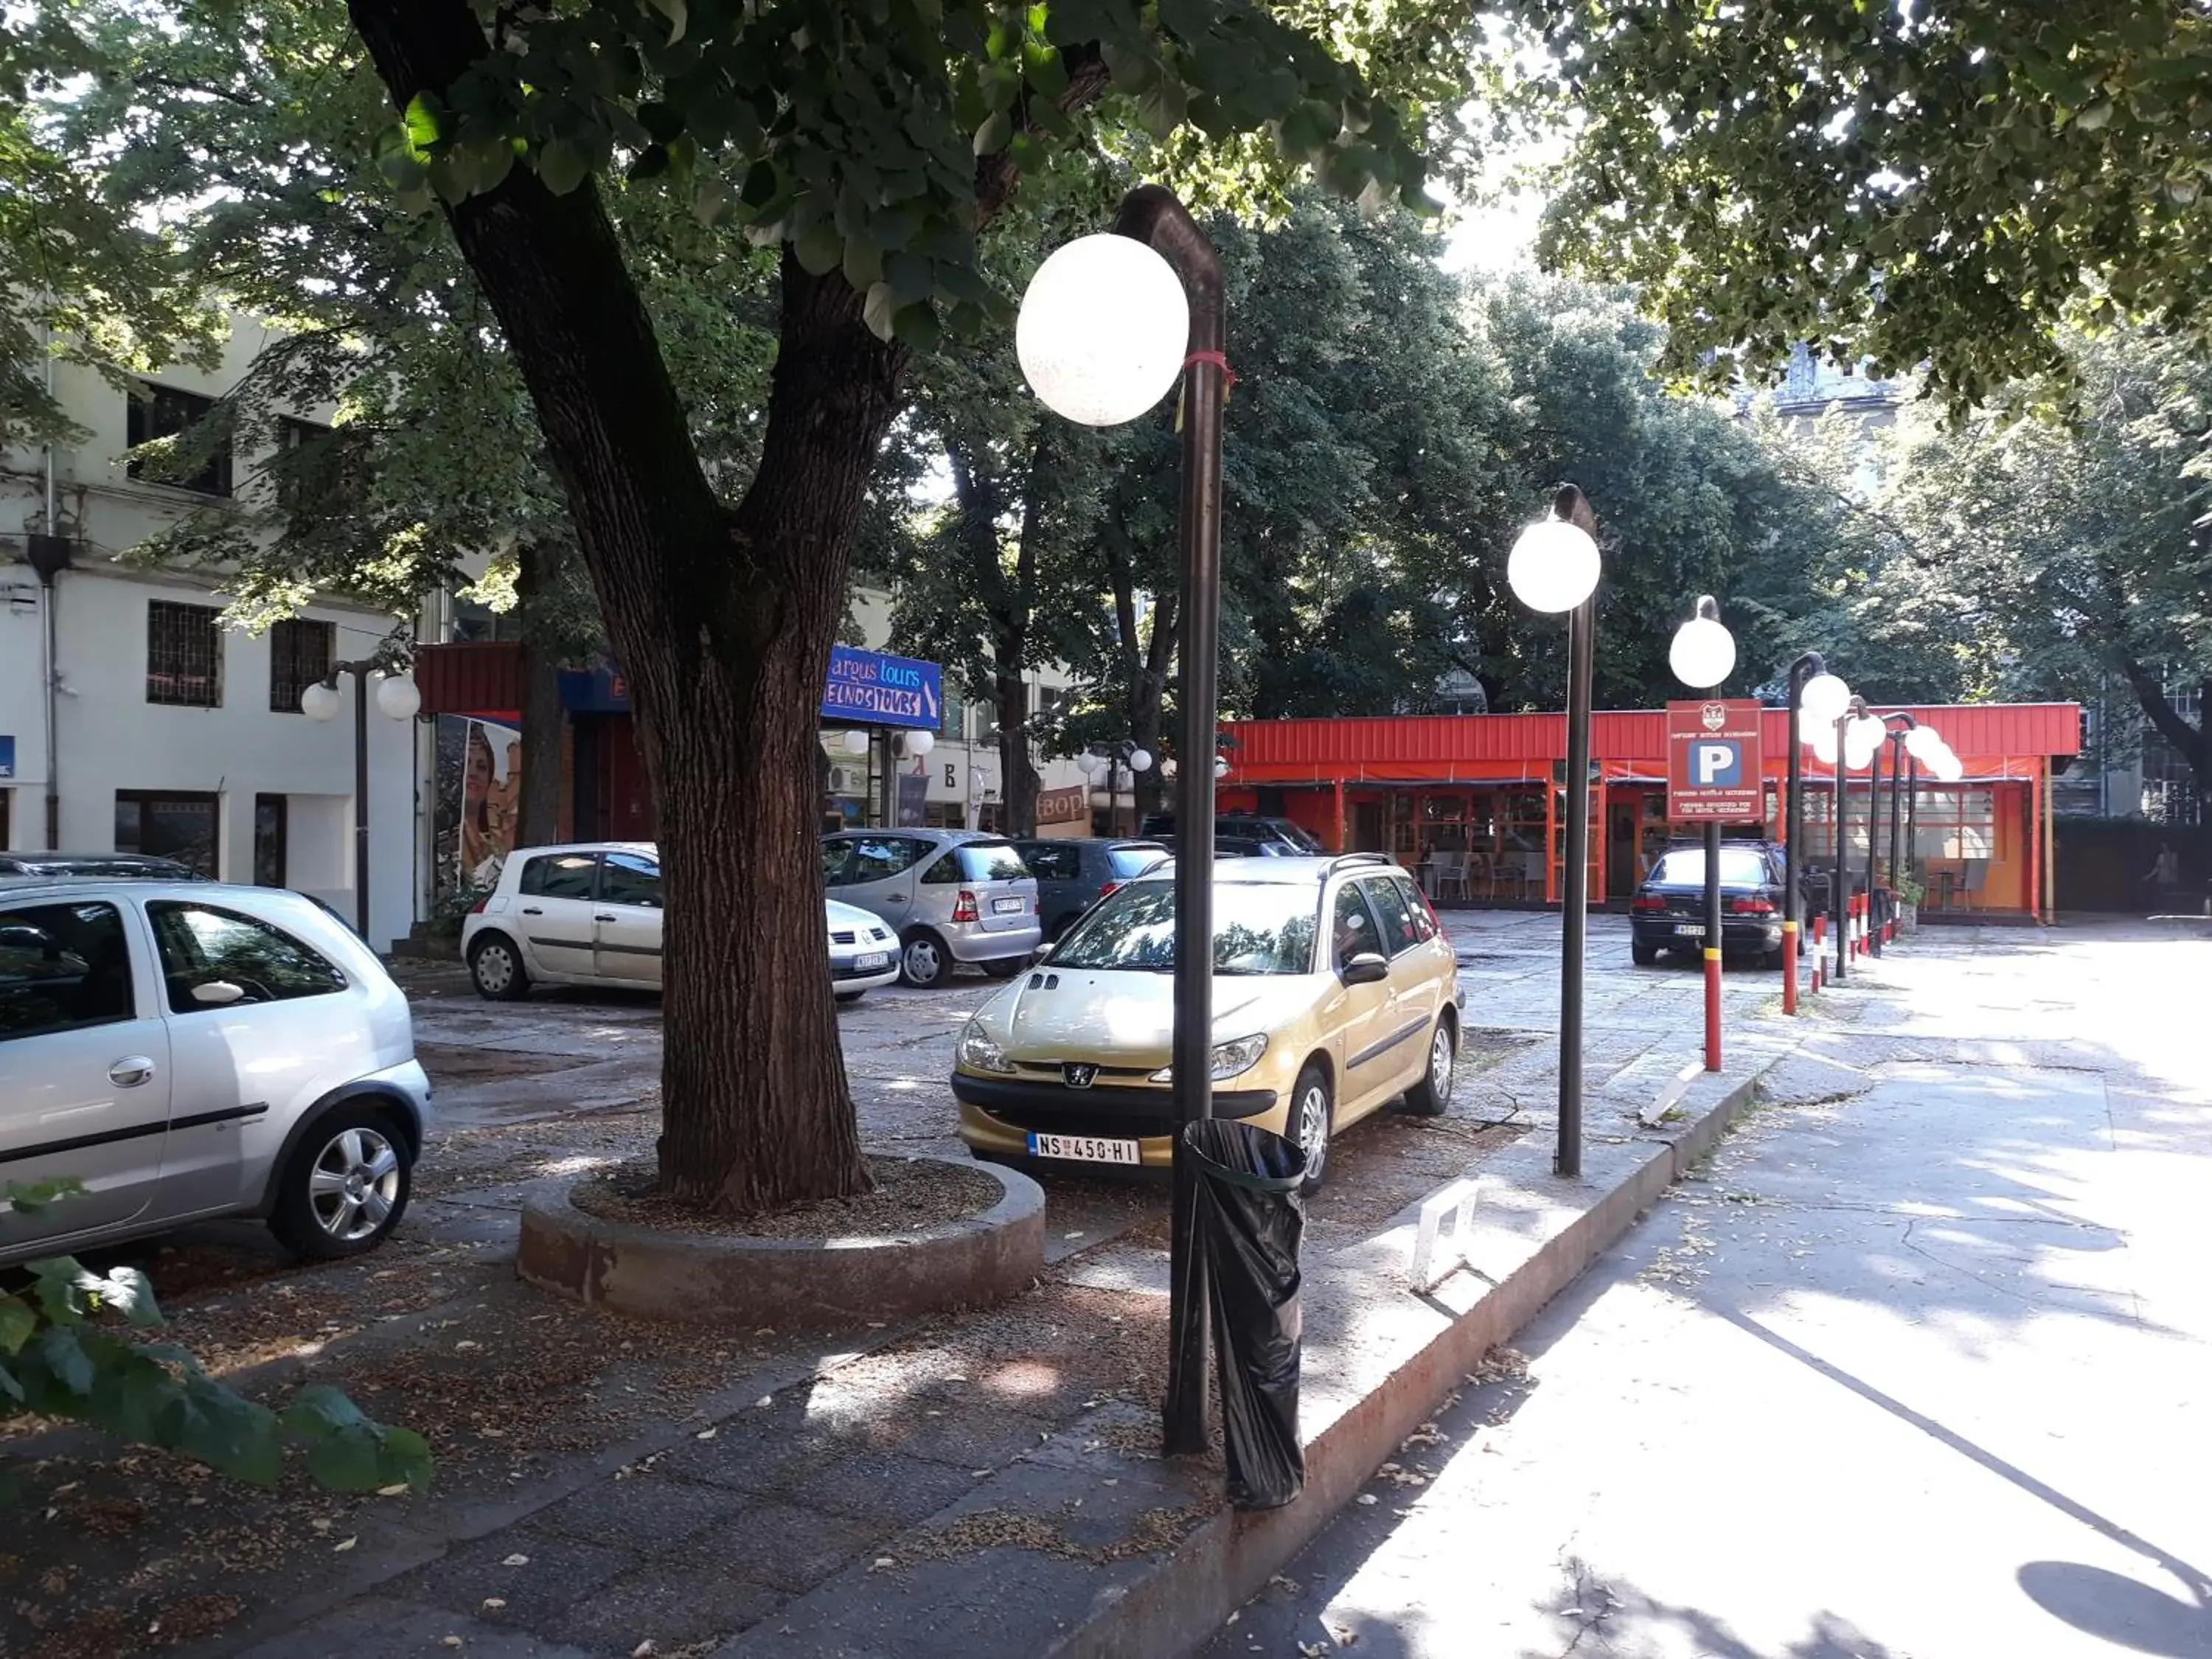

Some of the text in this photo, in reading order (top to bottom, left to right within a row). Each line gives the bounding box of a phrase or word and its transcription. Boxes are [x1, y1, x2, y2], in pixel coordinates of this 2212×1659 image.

[832, 658, 920, 687] argus tours
[827, 684, 917, 714] ELNOS TOURS
[1699, 745, 1733, 783] P
[1040, 1136, 1060, 1155] NS
